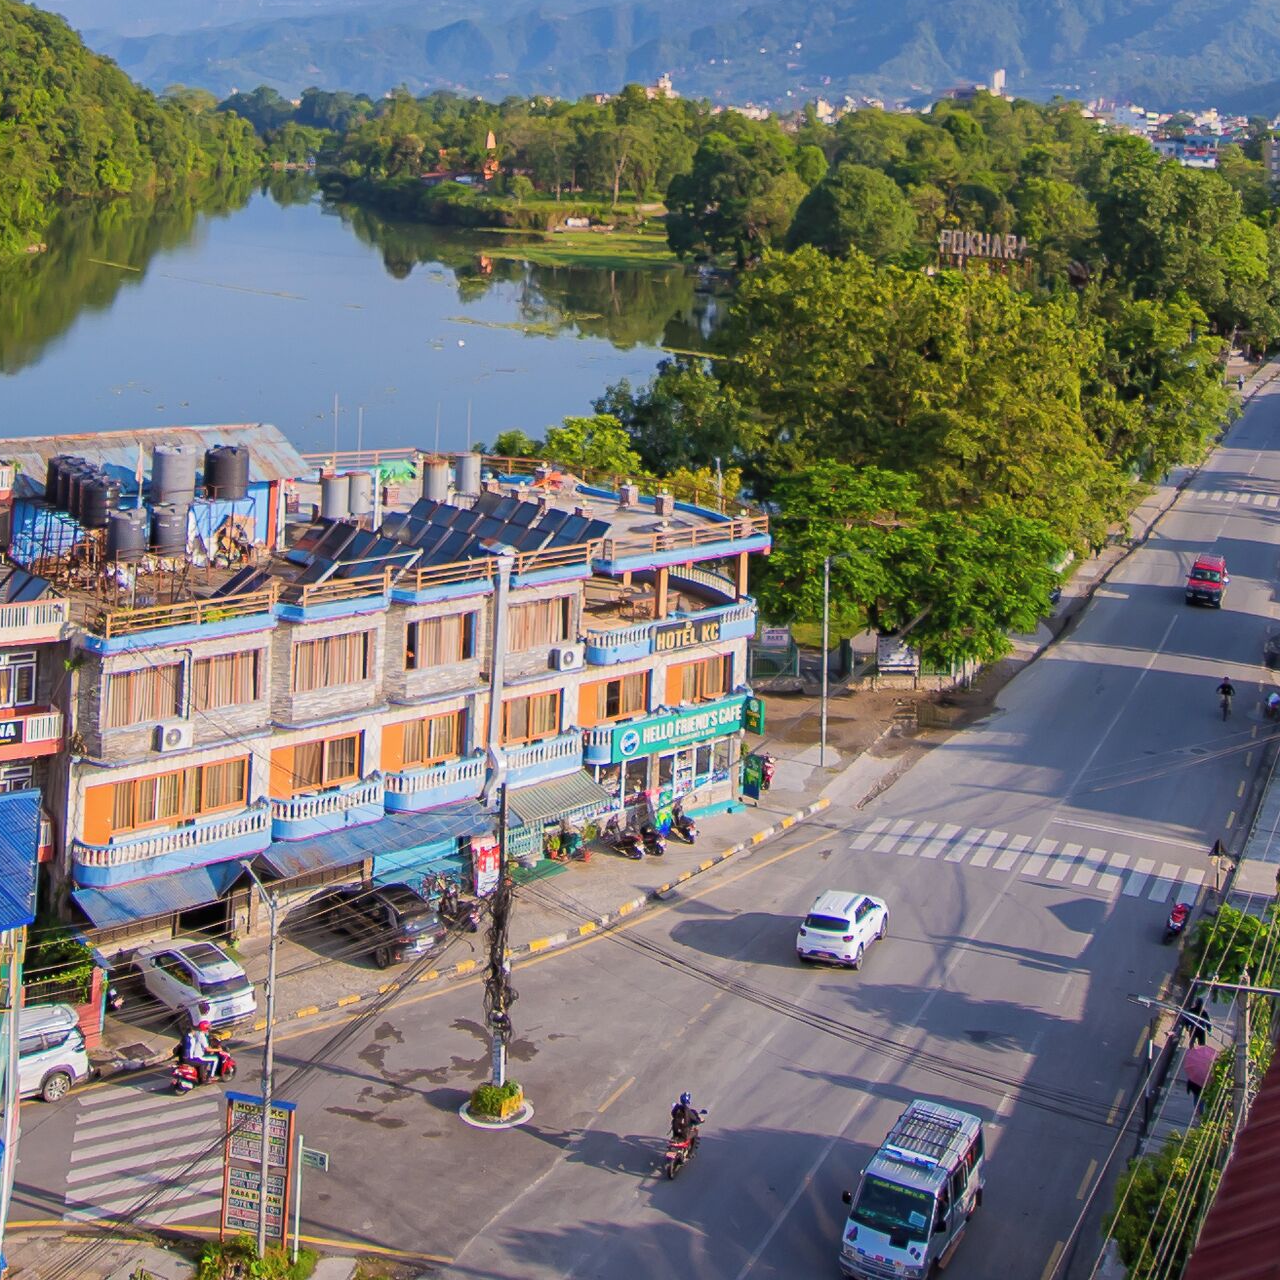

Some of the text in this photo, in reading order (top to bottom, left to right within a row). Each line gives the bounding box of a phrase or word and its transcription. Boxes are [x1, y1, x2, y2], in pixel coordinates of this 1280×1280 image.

[940, 229, 1027, 259] POKHARA
[656, 622, 719, 650] HOTEL KC
[643, 721, 674, 744] HELLO
[675, 710, 717, 735] FRIEND'S
[719, 704, 741, 725] CAFE
